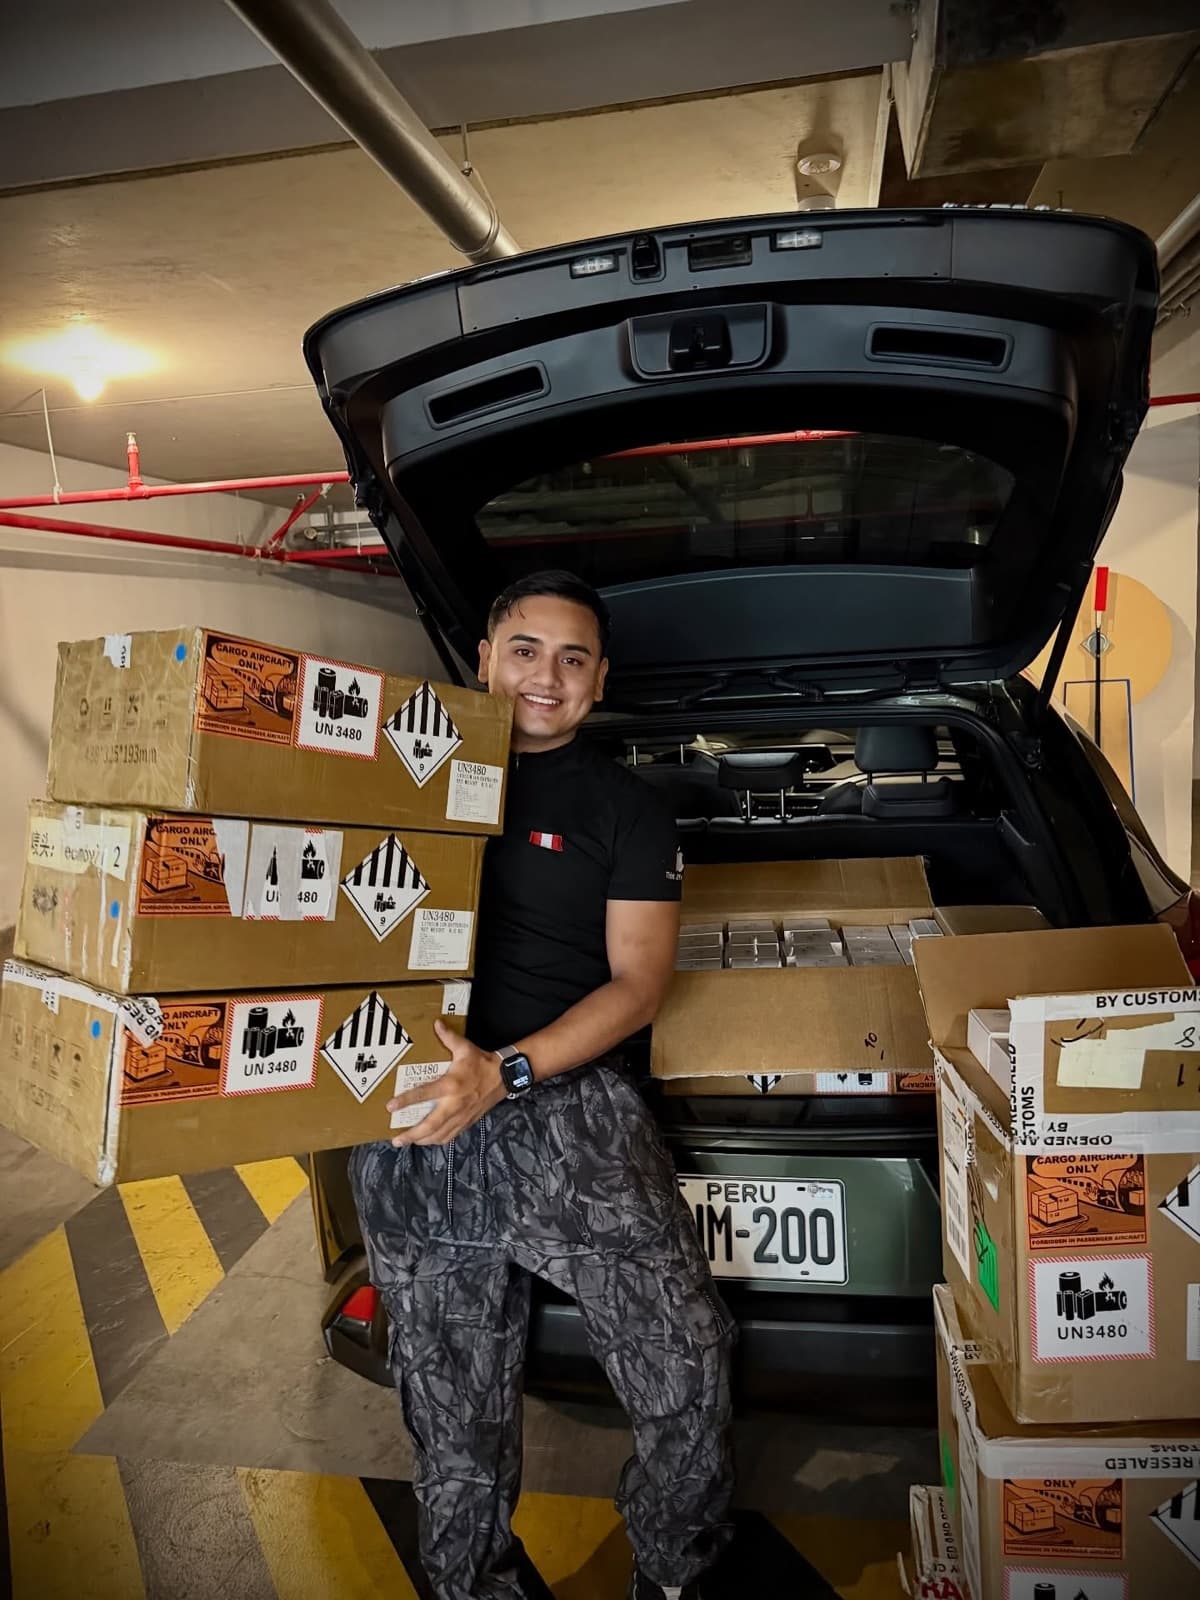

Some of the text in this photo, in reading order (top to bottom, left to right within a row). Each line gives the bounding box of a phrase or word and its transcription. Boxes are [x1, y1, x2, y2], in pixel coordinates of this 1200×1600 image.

[215, 642, 293, 669] CARGO AIRCRAFT
[238, 659, 264, 672] ONLY
[315, 721, 362, 741] UN 3480
[419, 763, 425, 772] 9
[457, 762, 487, 776] UN3480
[192, 826, 217, 836] AIRC
[180, 836, 208, 846] ONLY
[297, 891, 318, 904] 480
[380, 916, 386, 925] 9
[422, 910, 455, 922] UN3480
[1096, 995, 1119, 1009] BY
[172, 1009, 219, 1020] AIRCRAFT
[243, 1060, 298, 1077] UN 3480
[405, 1063, 439, 1077] UN3480
[361, 1077, 367, 1085] 9
[1047, 1121, 1068, 1133] BY
[1044, 1134, 1113, 1146] OPENED
[1037, 1154, 1077, 1165] CARGO
[1066, 1164, 1099, 1175] ONLY
[706, 1182, 776, 1203] PERU
[1032, 1237, 1068, 1246] FORBIDDEN
[1076, 1235, 1114, 1243] PASSENGER
[1114, 1233, 1145, 1241] AIRCRAFT
[1057, 1324, 1128, 1340] UN3480
[1150, 1444, 1200, 1453] TOMS
[1105, 1456, 1194, 1471] RESEALED
[1043, 1479, 1078, 1489] ONLY
